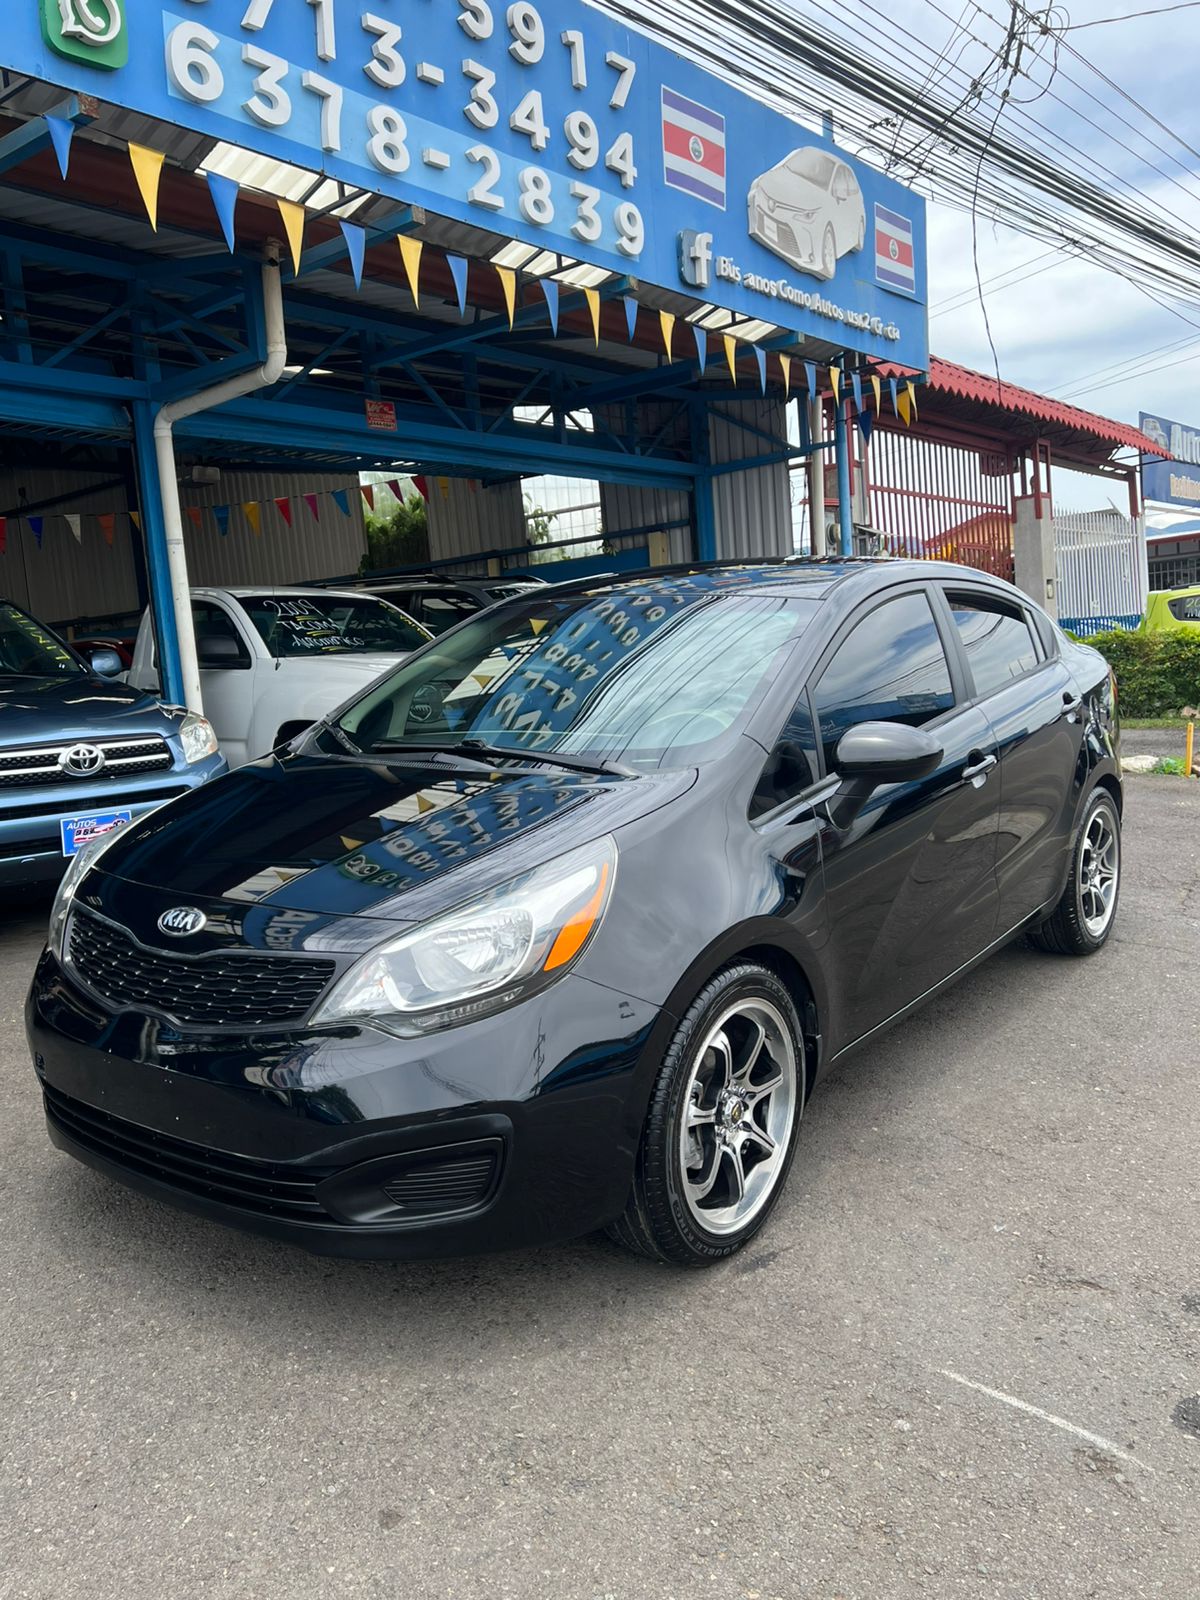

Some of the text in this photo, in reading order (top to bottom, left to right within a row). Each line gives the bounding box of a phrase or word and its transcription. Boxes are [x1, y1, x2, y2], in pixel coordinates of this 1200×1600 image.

[190, 0, 638, 189] 13-3494
[166, 20, 645, 257] 6378-2839
[811, 293, 844, 320] Autos
[263, 599, 325, 617] 2009
[66, 818, 97, 831] AUTOS
